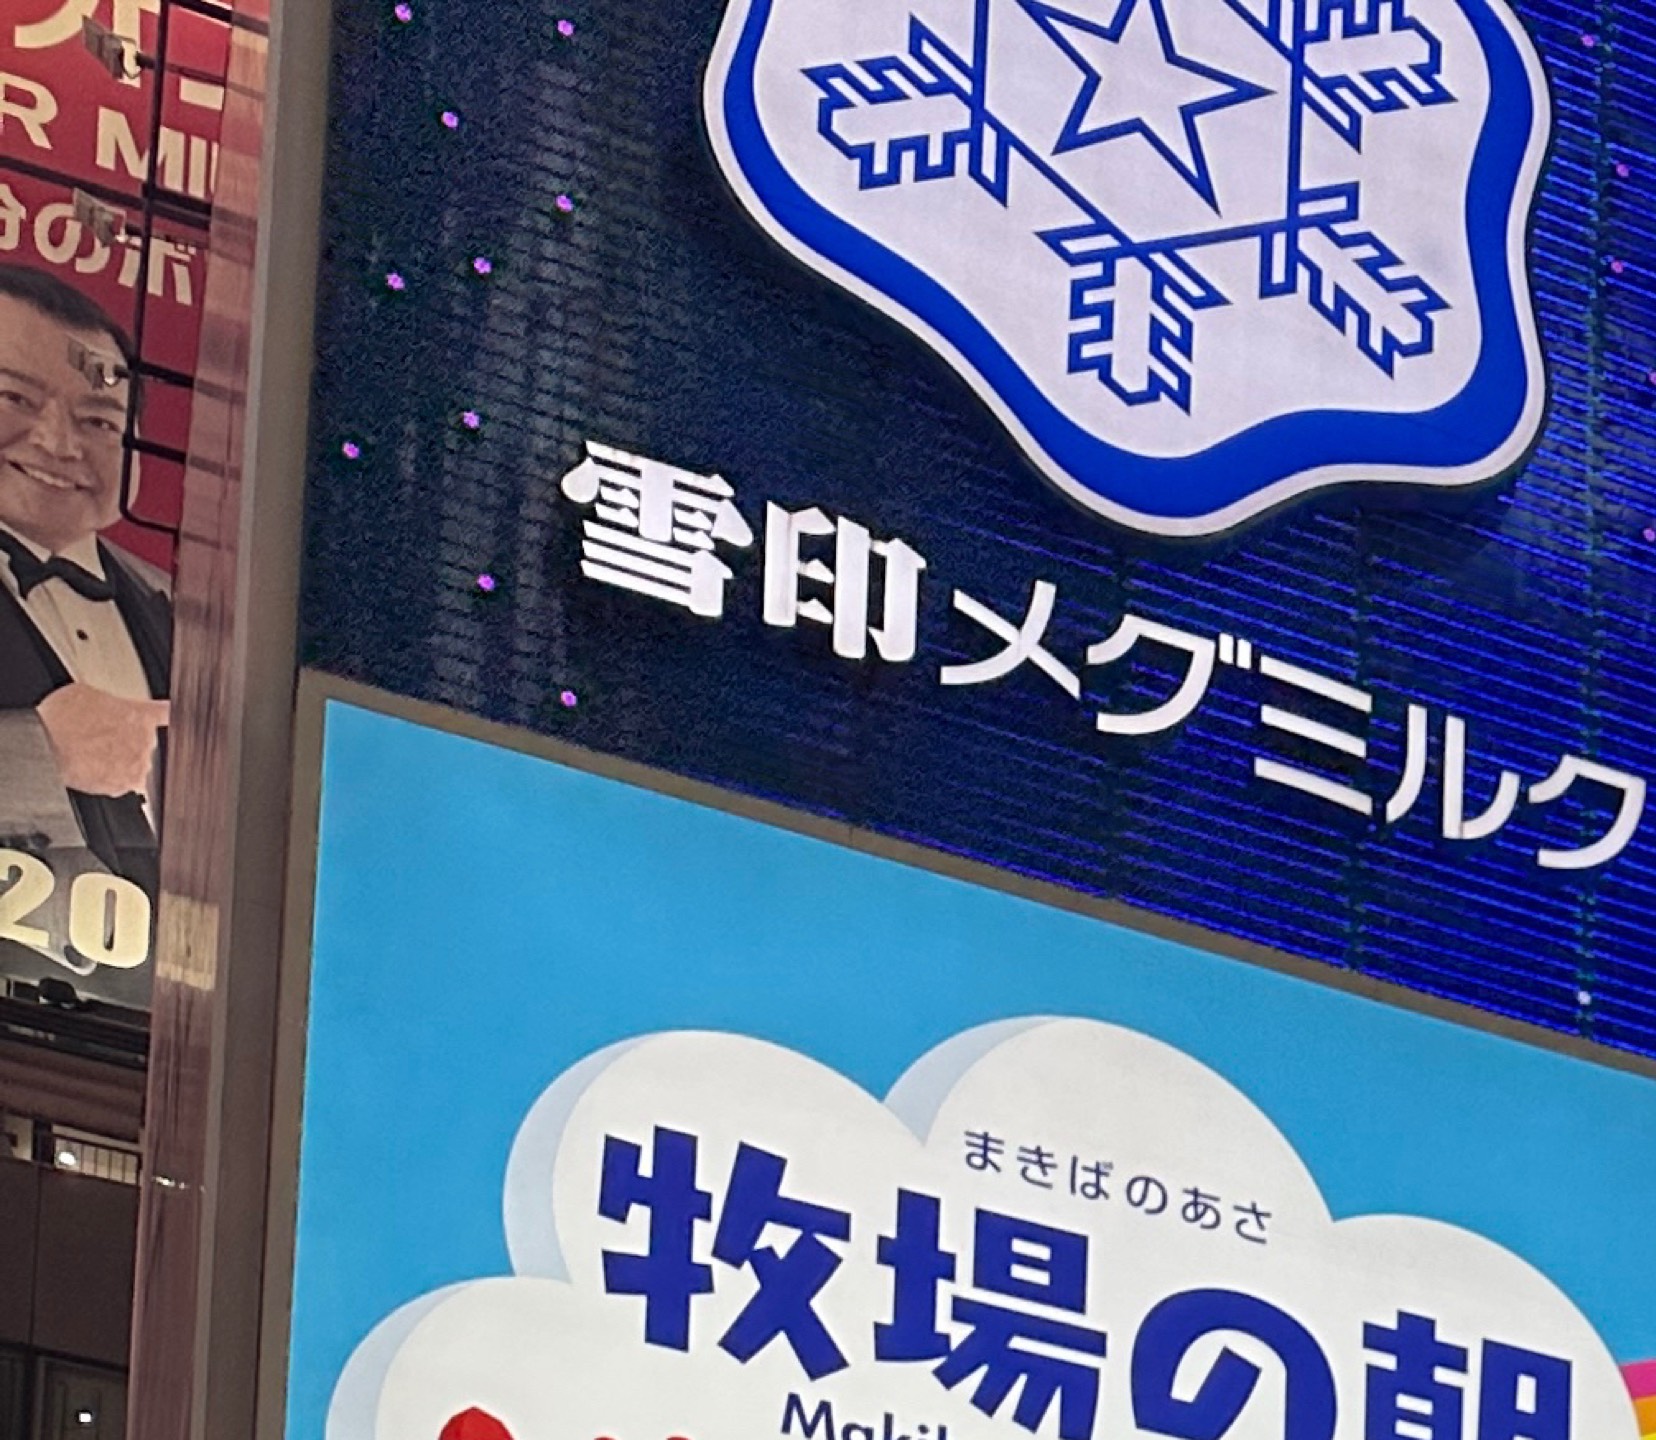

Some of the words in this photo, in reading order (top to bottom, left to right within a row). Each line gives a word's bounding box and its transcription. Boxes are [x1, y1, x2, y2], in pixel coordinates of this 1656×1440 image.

[96, 106, 219, 199] MI
[560, 441, 1645, 869] 雪印メグミルク
[963, 1129, 1273, 1246] まきばのあさ
